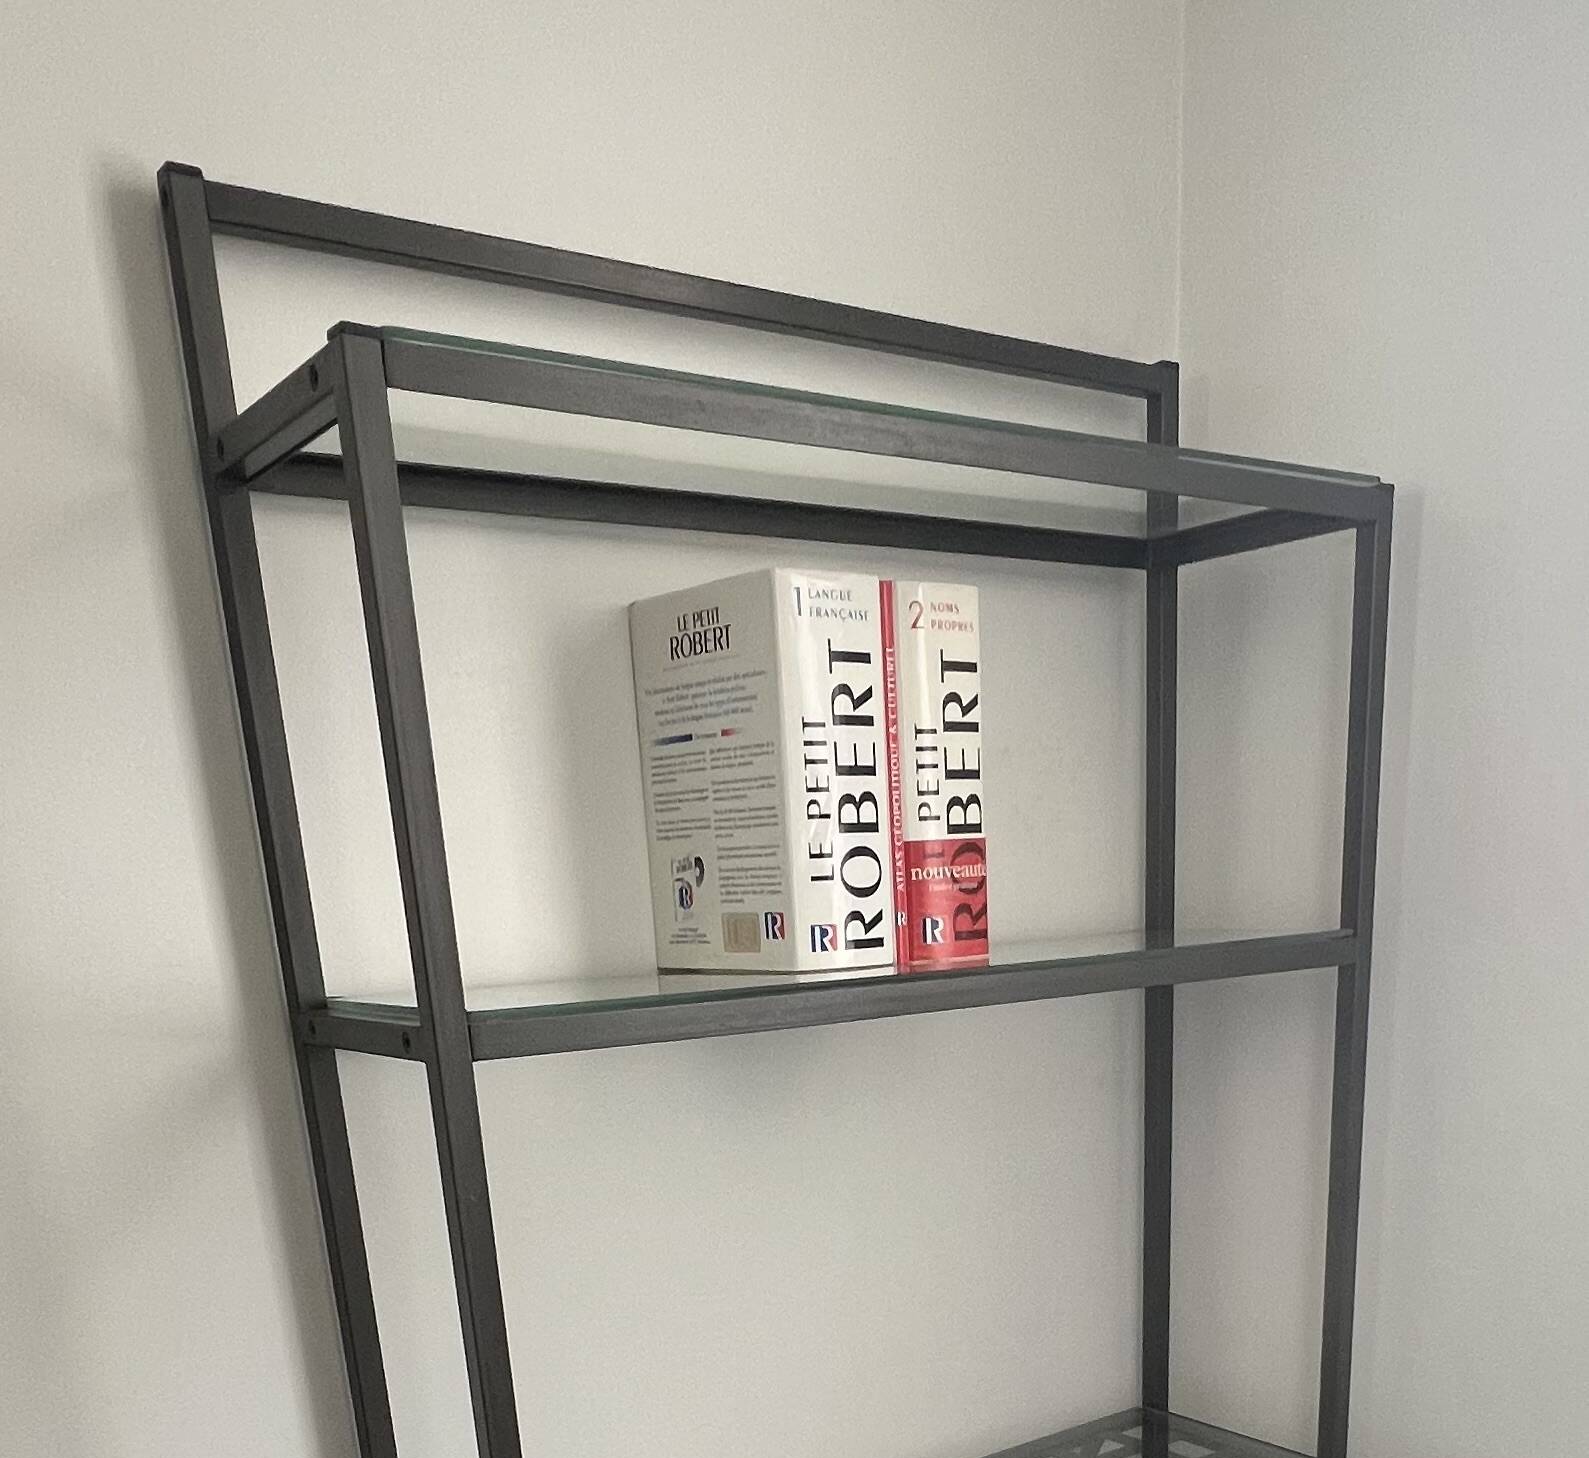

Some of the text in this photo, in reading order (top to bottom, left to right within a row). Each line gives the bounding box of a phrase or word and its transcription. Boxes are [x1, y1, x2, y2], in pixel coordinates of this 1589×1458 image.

[794, 587, 802, 617] 1
[808, 588, 853, 602] LANGUE
[930, 602, 960, 615] NOMS
[677, 606, 719, 632] LE PETIT
[809, 606, 869, 623] FRANÇAISE
[908, 600, 925, 629] 2
[930, 621, 975, 633] PROPRES
[669, 624, 732, 661] ROBERT
[914, 722, 941, 822] PETIT
[802, 716, 835, 882] LE PETIT
[827, 638, 885, 951] ROBERT
[940, 648, 988, 941] ROBERT
[894, 849, 906, 892] ATLAS
